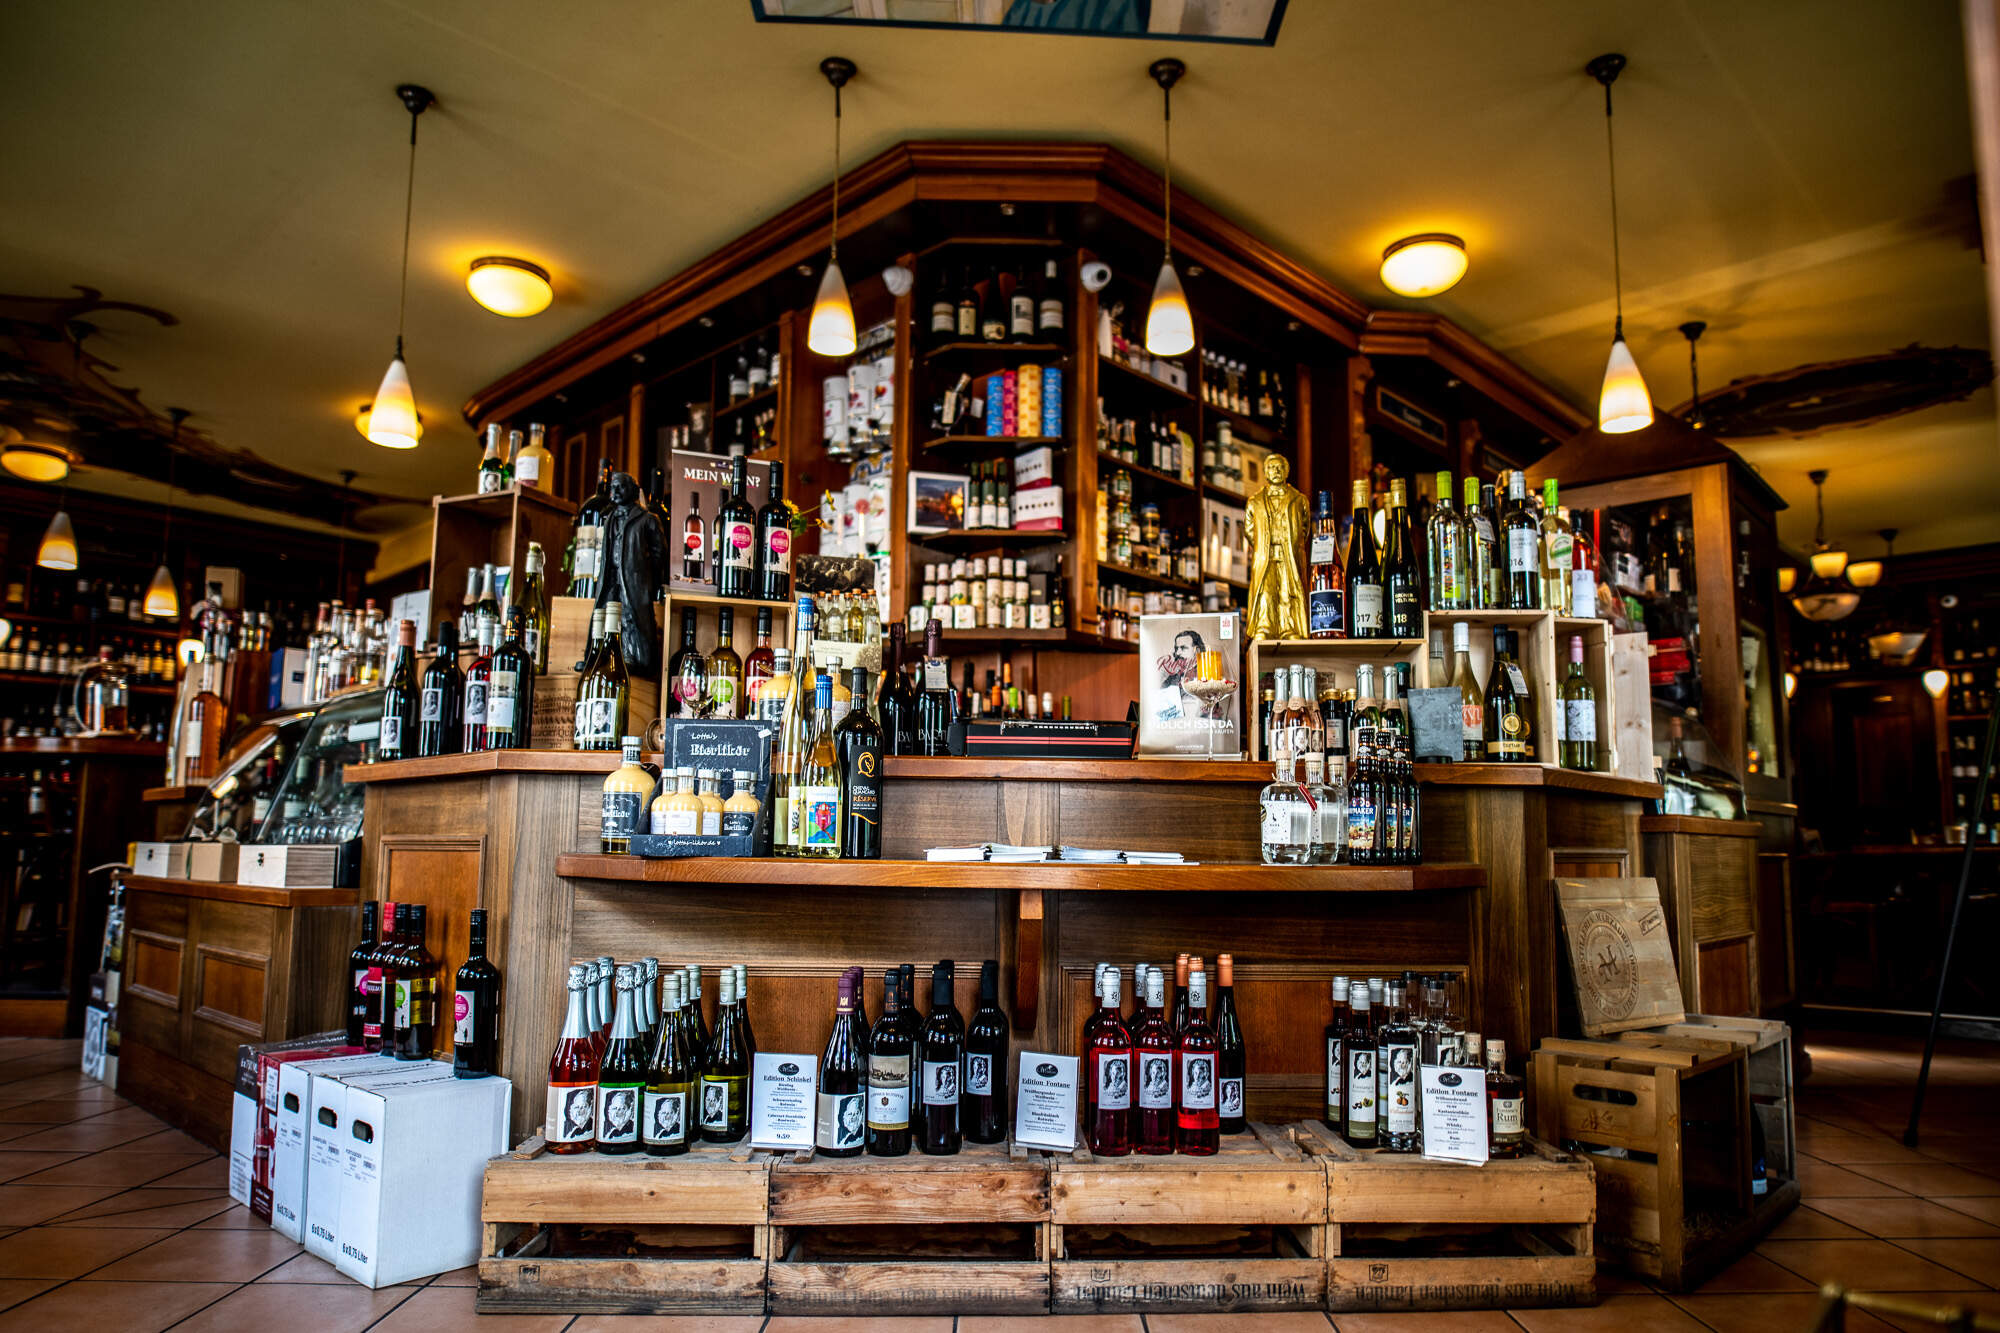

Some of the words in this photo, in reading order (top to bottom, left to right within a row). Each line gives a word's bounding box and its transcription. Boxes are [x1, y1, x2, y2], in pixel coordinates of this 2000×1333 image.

[684, 467, 718, 482] MEIN
[721, 472, 761, 488] WN?
[1218, 720, 1234, 729] DA
[691, 732, 718, 740] Lotta's
[690, 742, 751, 756] Eierlikör
[763, 1074, 785, 1082] Edition
[786, 1075, 812, 1083] Schinkel
[1022, 1078, 1044, 1086] Edition
[1046, 1080, 1071, 1088] Fontane
[1426, 1087, 1449, 1095] Edition
[1451, 1089, 1478, 1097] Fontane
[1496, 1112, 1518, 1121] Rum
[325, 1230, 335, 1242] Liter
[358, 1249, 369, 1264] Liter
[1143, 1283, 1228, 1303] deutschen
[1231, 1283, 1261, 1299] aus
[1418, 1284, 1499, 1305] deutschen
[1504, 1283, 1533, 1300] aus
